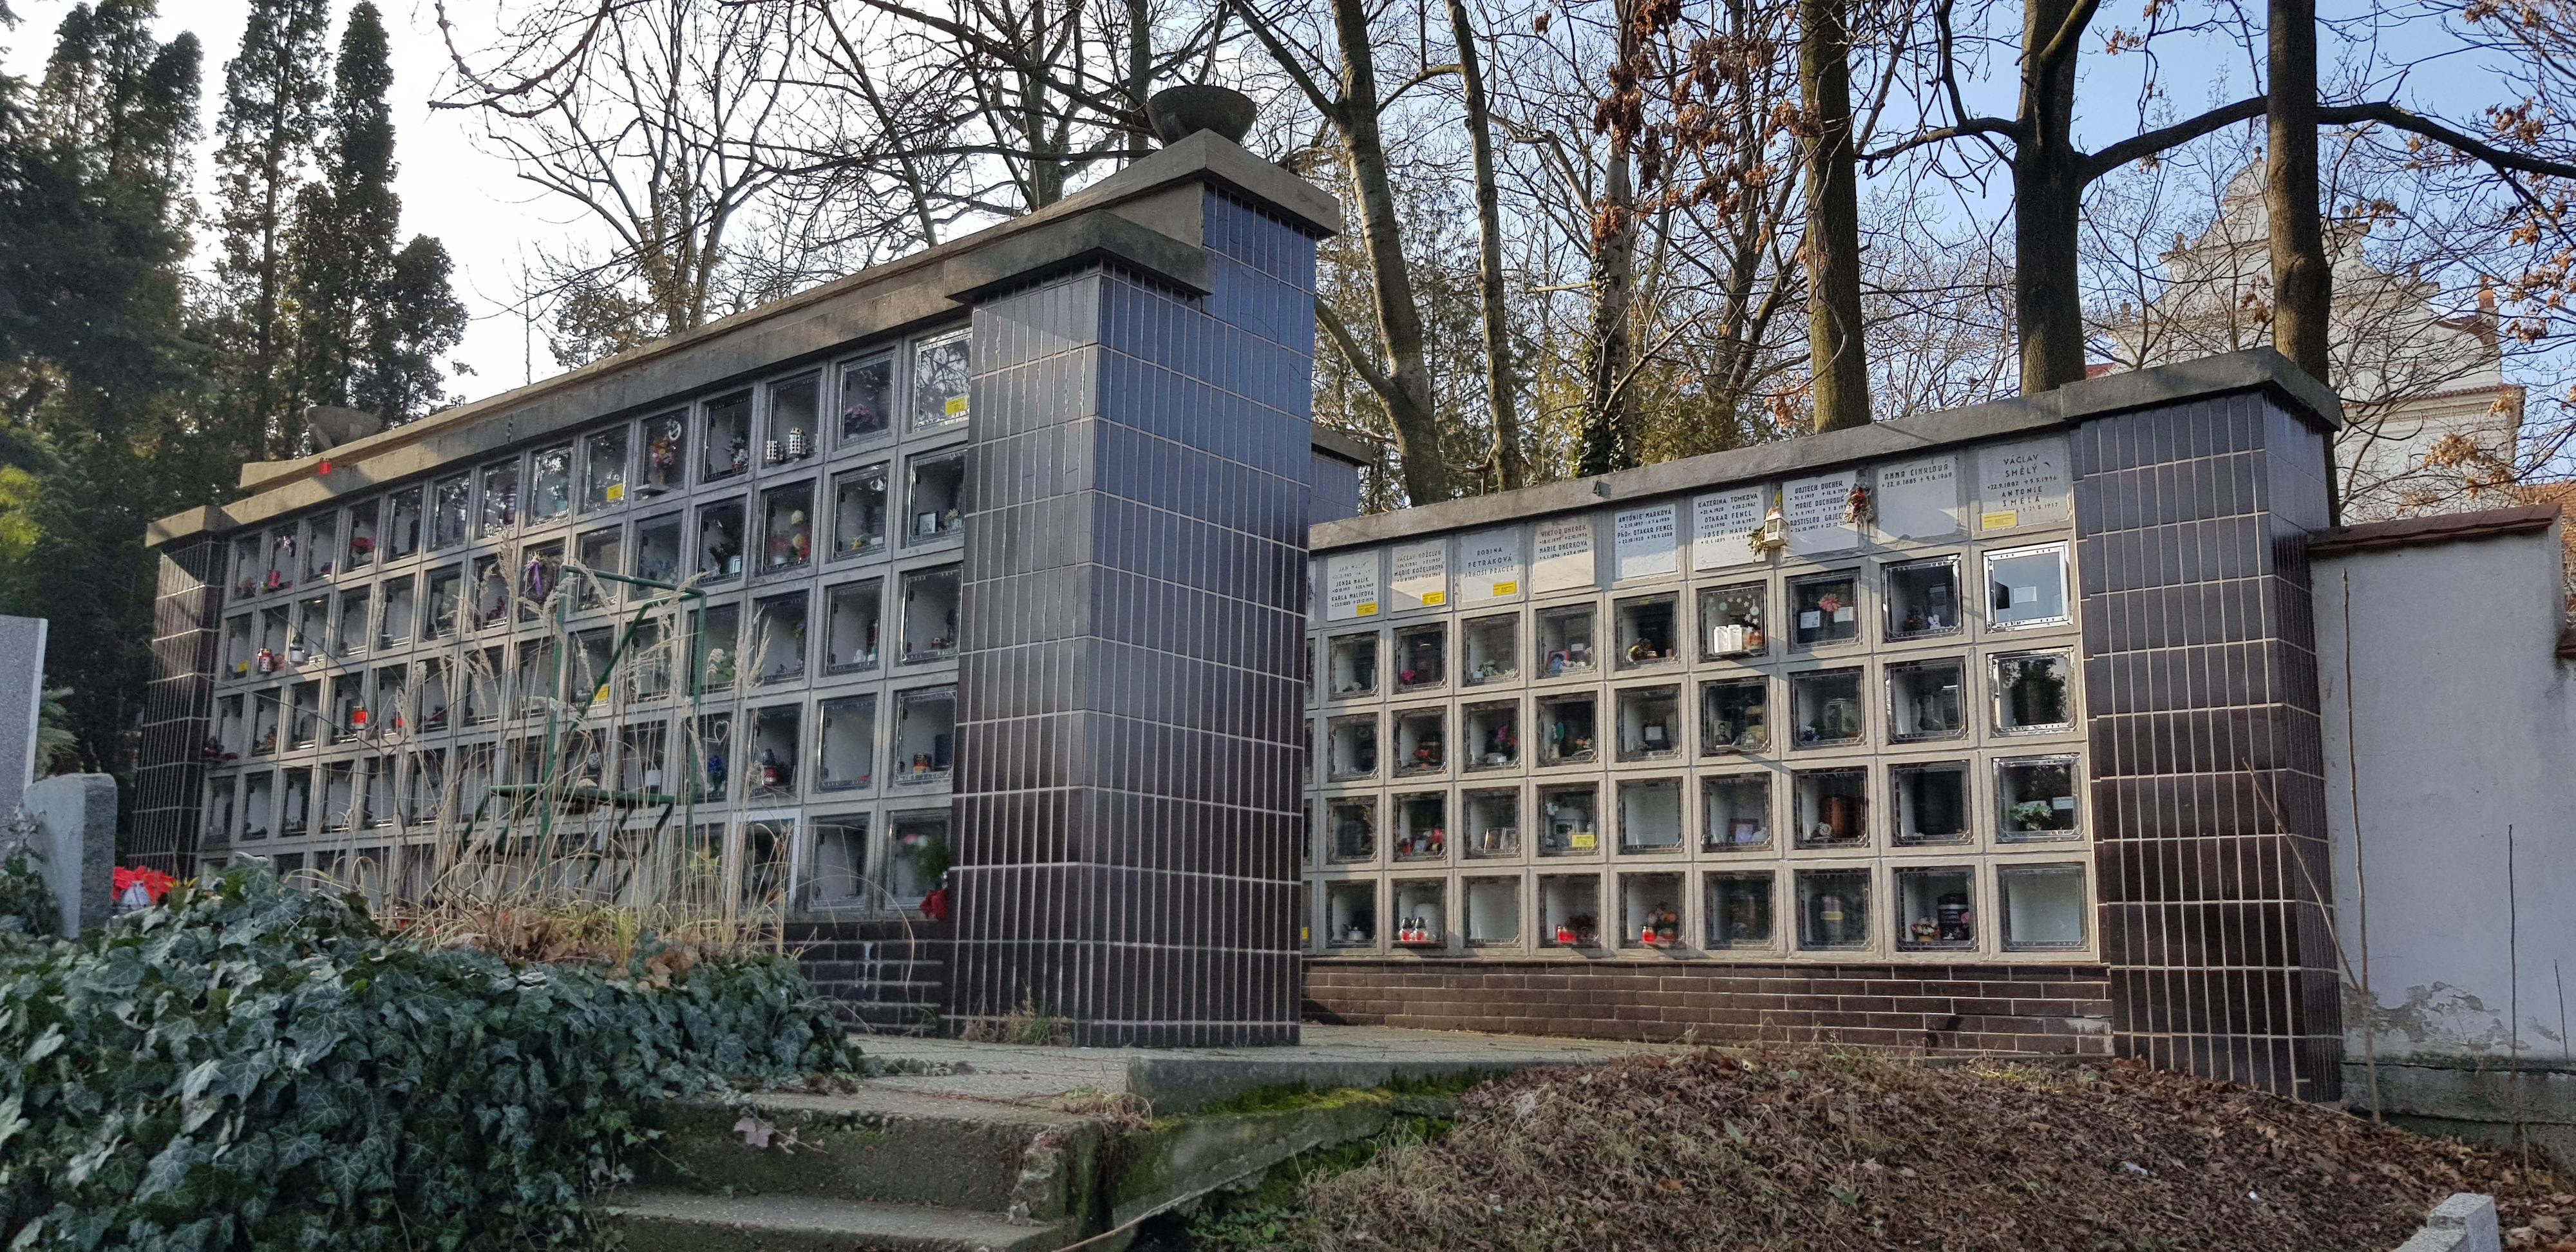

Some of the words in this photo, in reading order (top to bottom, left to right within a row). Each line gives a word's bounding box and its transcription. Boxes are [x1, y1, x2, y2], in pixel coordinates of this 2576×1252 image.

[2003, 454, 2038, 465] VÁCLAV
[1884, 471, 1905, 480] ANNA
[2002, 486, 2043, 497] ANTONIE
[1618, 513, 1642, 522] ANTONIE
[1645, 508, 1671, 518] MARKOVÁ
[1705, 514, 1728, 523] OTAKAR
[1824, 513, 1844, 521] GAJEC
[1541, 529, 1562, 537] VIKTOR
[1703, 530, 1724, 538] JOSEF
[1729, 526, 1752, 535] MAREK
[1477, 547, 1502, 556] RODINA
[1468, 553, 1512, 568] PETRÁKOVÁ
